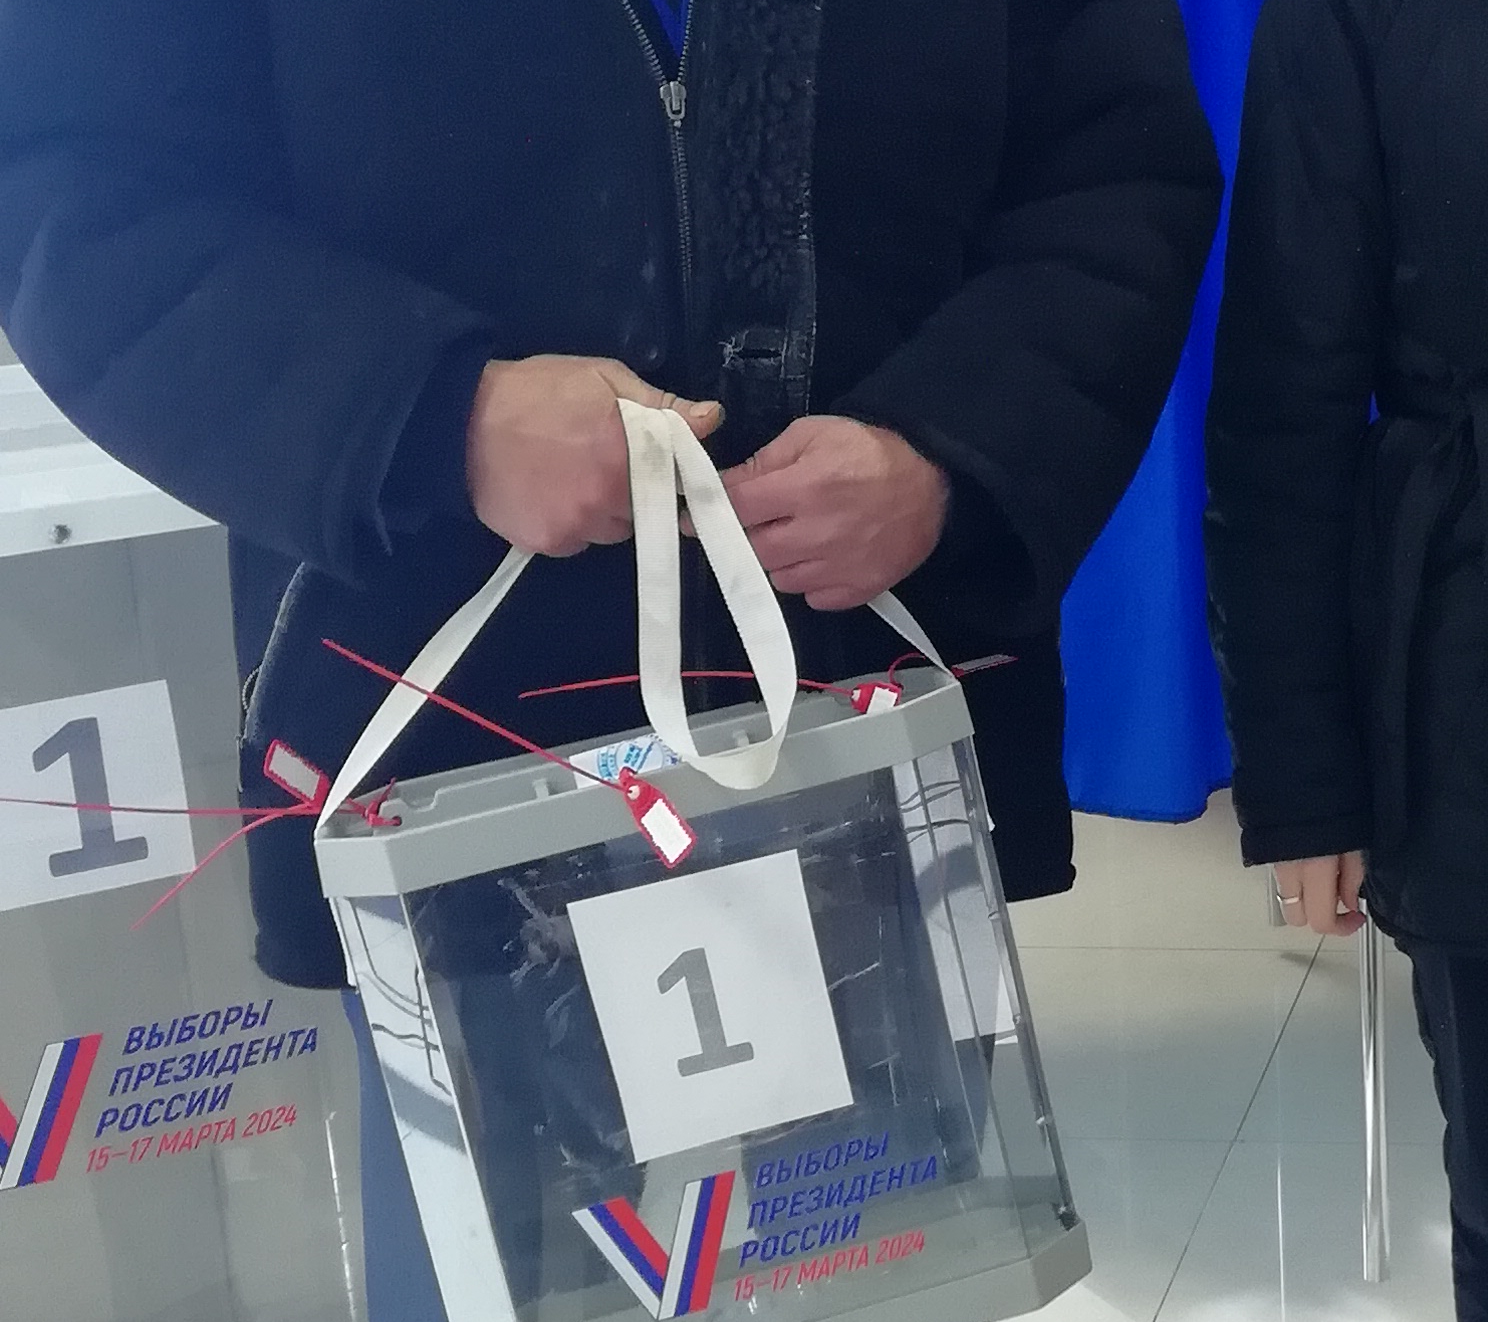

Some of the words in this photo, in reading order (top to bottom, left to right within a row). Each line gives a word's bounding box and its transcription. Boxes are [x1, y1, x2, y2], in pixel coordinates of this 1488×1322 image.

[33, 717, 149, 877] 1
[122, 999, 273, 1055] ВЫБОРЫ
[656, 946, 755, 1077] 1
[108, 1027, 318, 1096] ПРЕЗИДЕНТА
[94, 1082, 233, 1138] РОССИИ
[156, 1117, 237, 1157] МАРТА
[241, 1104, 298, 1139] 2024
[756, 1131, 889, 1189] ВЫБОРЫ
[747, 1155, 938, 1230] ПРЕЗИДЕНТА
[739, 1212, 861, 1269] РОССИИ
[797, 1244, 868, 1285] МАРТА
[875, 1230, 925, 1264] 2024
